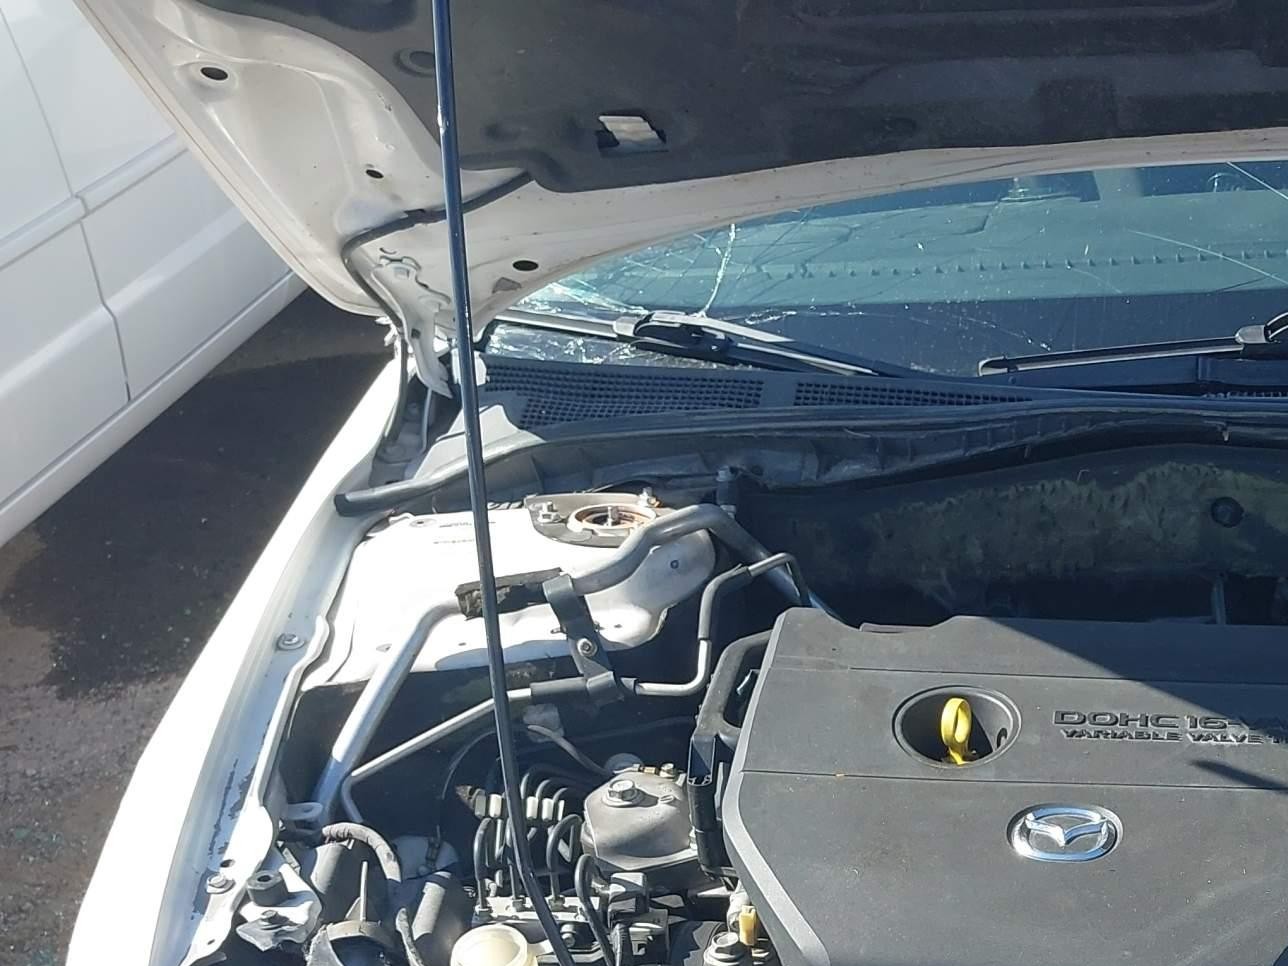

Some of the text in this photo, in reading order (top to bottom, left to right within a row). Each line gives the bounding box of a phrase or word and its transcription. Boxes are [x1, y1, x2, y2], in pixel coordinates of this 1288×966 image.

[1053, 710, 1180, 729] DOHC
[1061, 729, 1183, 742] VARIABLE
[1187, 733, 1265, 745] VALVE
